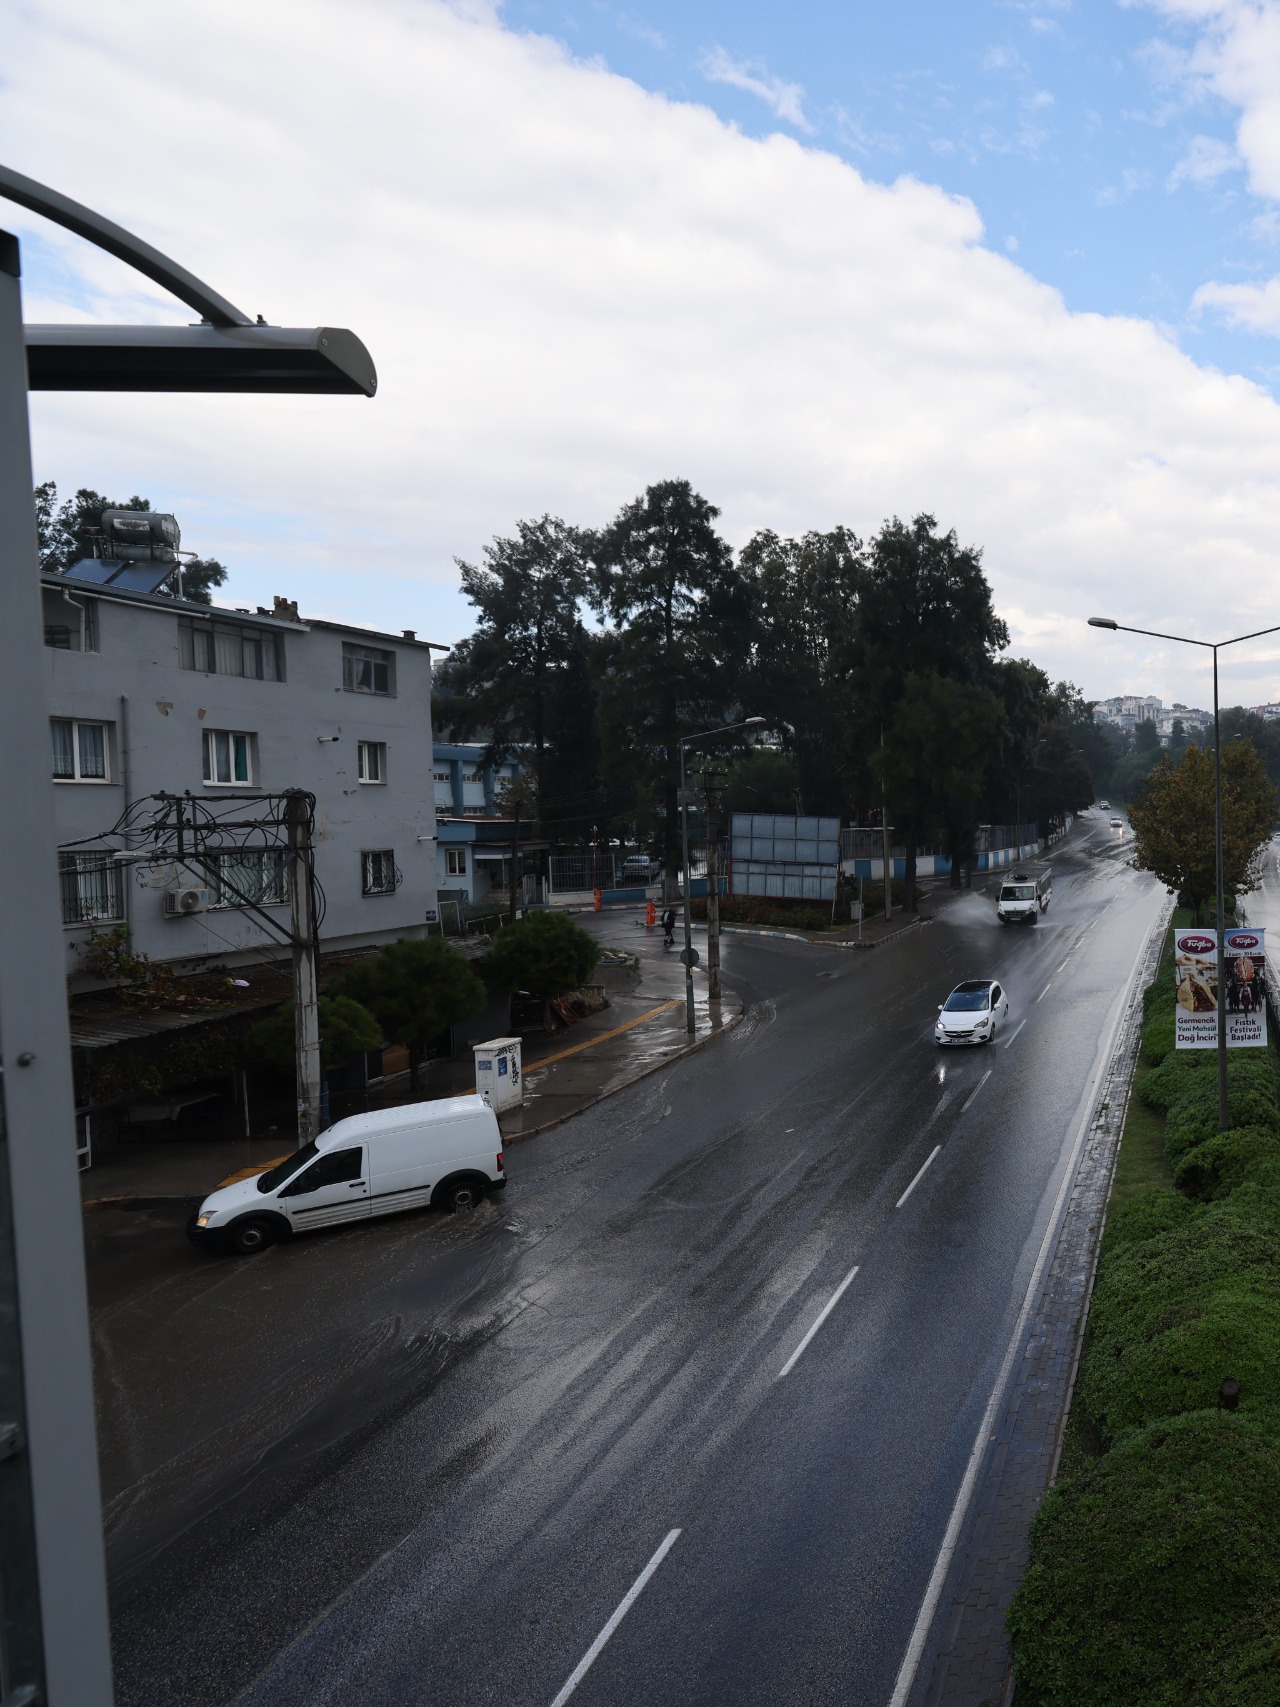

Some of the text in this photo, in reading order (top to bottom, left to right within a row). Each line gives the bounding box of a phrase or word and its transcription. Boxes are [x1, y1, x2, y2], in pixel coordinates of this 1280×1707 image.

[1177, 1016, 1216, 1024] Germencik
[1235, 1018, 1257, 1026] Fıstık
[1230, 1025, 1262, 1033] Festivali
[1178, 1032, 1216, 1043] Dağ İnciri
[1231, 1033, 1261, 1041] Başladı!
